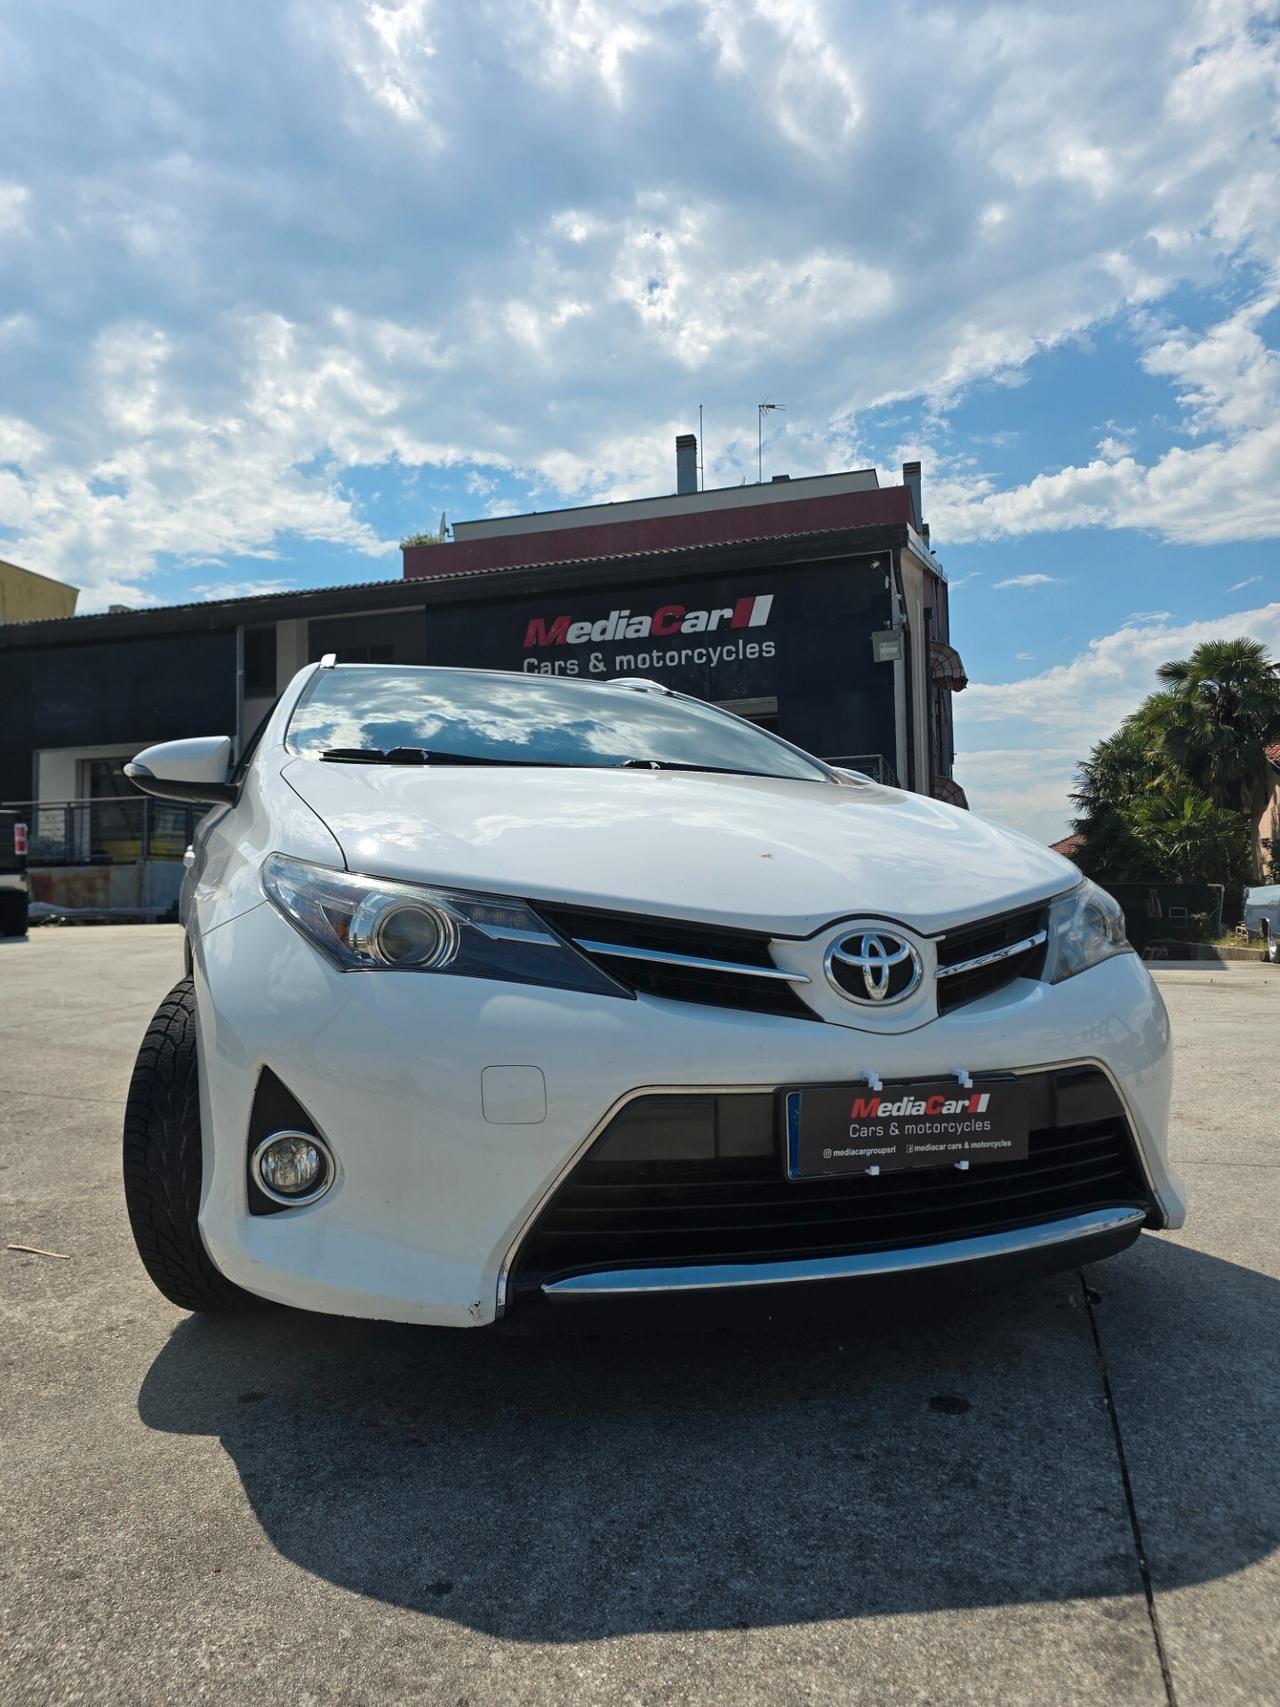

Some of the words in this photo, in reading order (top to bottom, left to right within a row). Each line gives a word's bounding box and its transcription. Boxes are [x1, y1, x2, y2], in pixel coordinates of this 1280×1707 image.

[523, 604, 733, 648] MediaCar
[523, 657, 579, 675] Cars
[588, 652, 607, 673] &
[615, 639, 776, 671] motorcycles
[850, 1094, 970, 1118] MediaCar
[849, 1123, 884, 1138] Cars
[889, 1121, 900, 1136] &
[904, 1119, 991, 1135] motorcycles
[914, 1143, 947, 1152] mediacar
[947, 1142, 962, 1151] cars
[963, 1141, 970, 1149] &
[970, 1139, 1012, 1149] motorcycles
